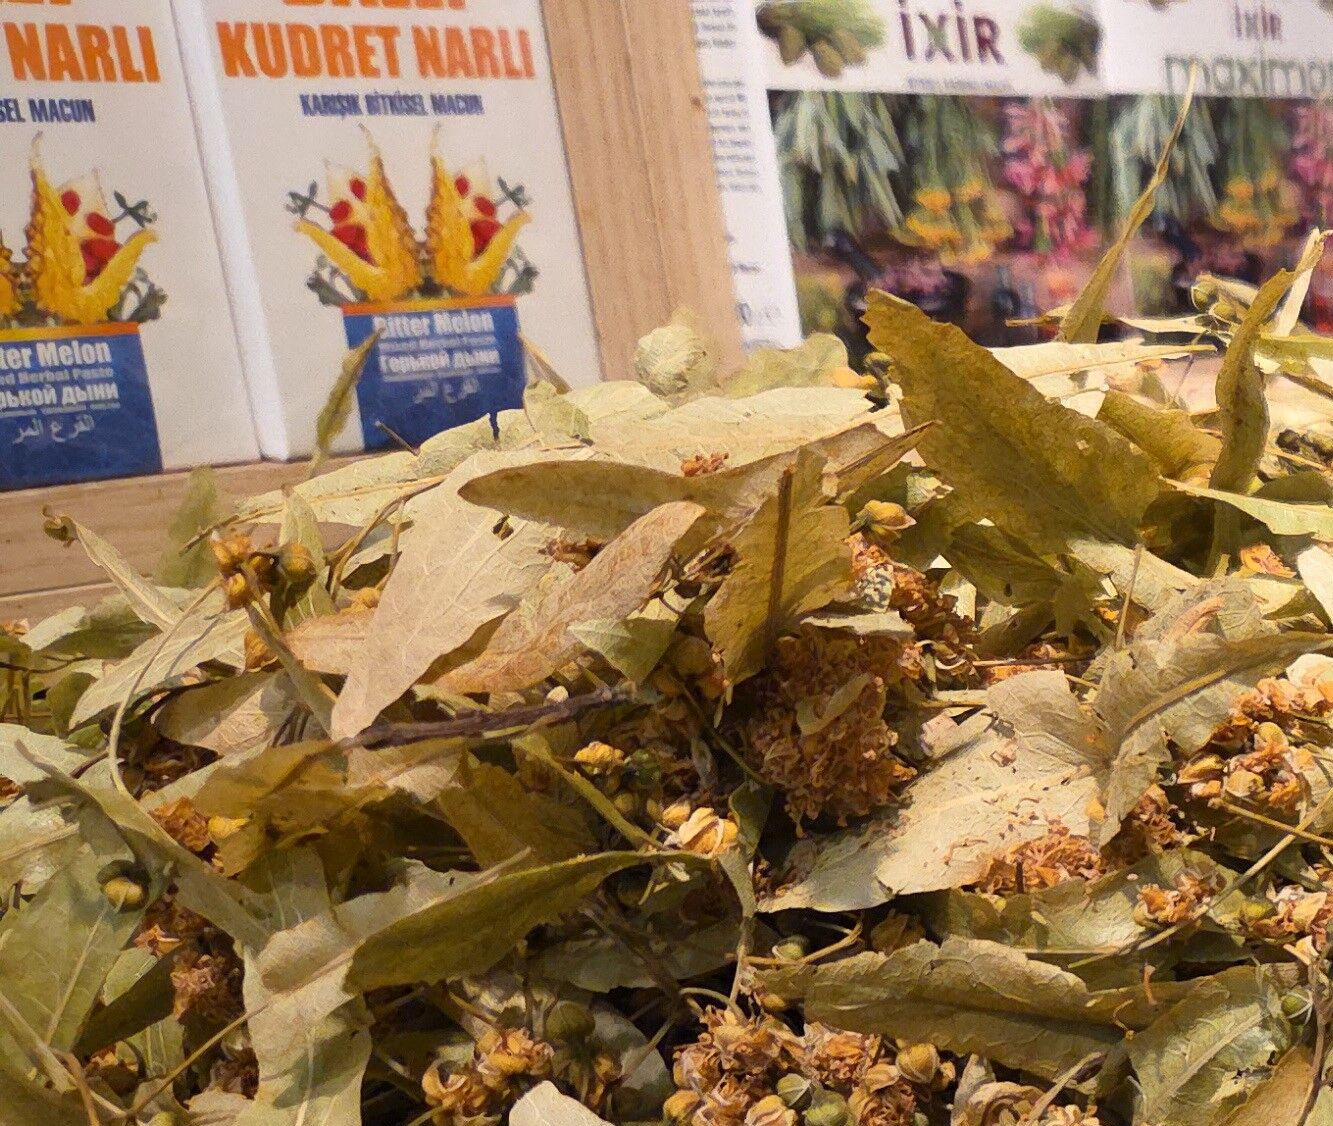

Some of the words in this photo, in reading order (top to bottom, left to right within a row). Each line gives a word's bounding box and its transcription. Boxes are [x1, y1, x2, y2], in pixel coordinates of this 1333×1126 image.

[3, 22, 161, 82] NARLI
[216, 22, 400, 78] KUDRET
[411, 25, 535, 79] NARLI
[28, 97, 96, 122] MACUN
[36, 340, 113, 368] Melon
